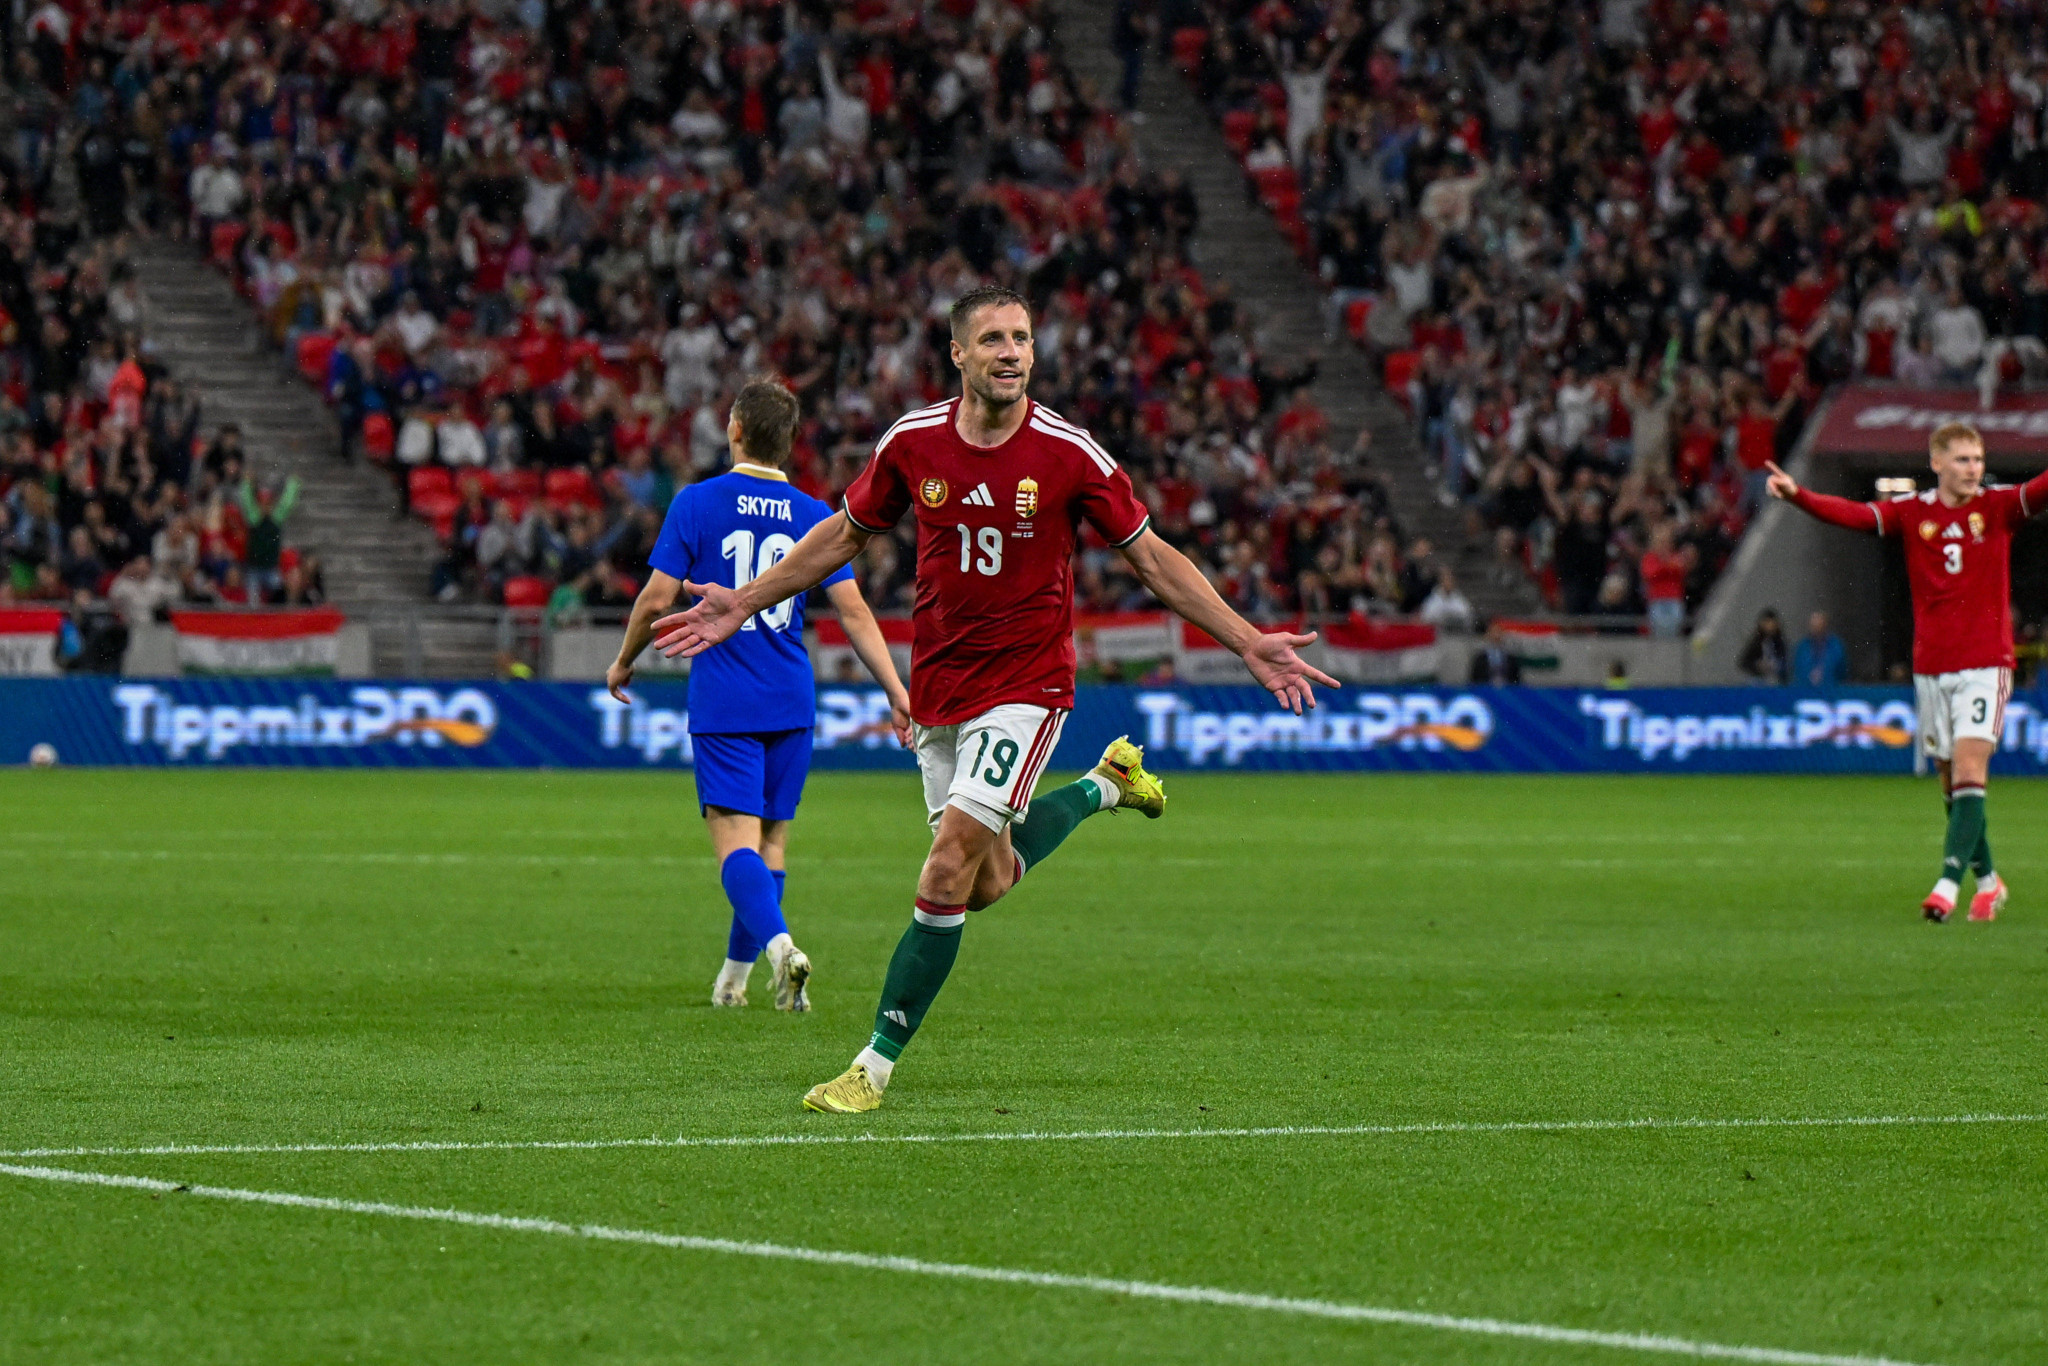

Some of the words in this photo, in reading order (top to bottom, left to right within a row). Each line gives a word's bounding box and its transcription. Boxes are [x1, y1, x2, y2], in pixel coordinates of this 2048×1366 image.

[736, 494, 792, 522] SKYTTÄ
[957, 523, 1003, 576] 19
[1942, 543, 1963, 575] 3
[721, 529, 798, 633] 10
[1971, 698, 1987, 724] 3
[970, 730, 1019, 788] 19
